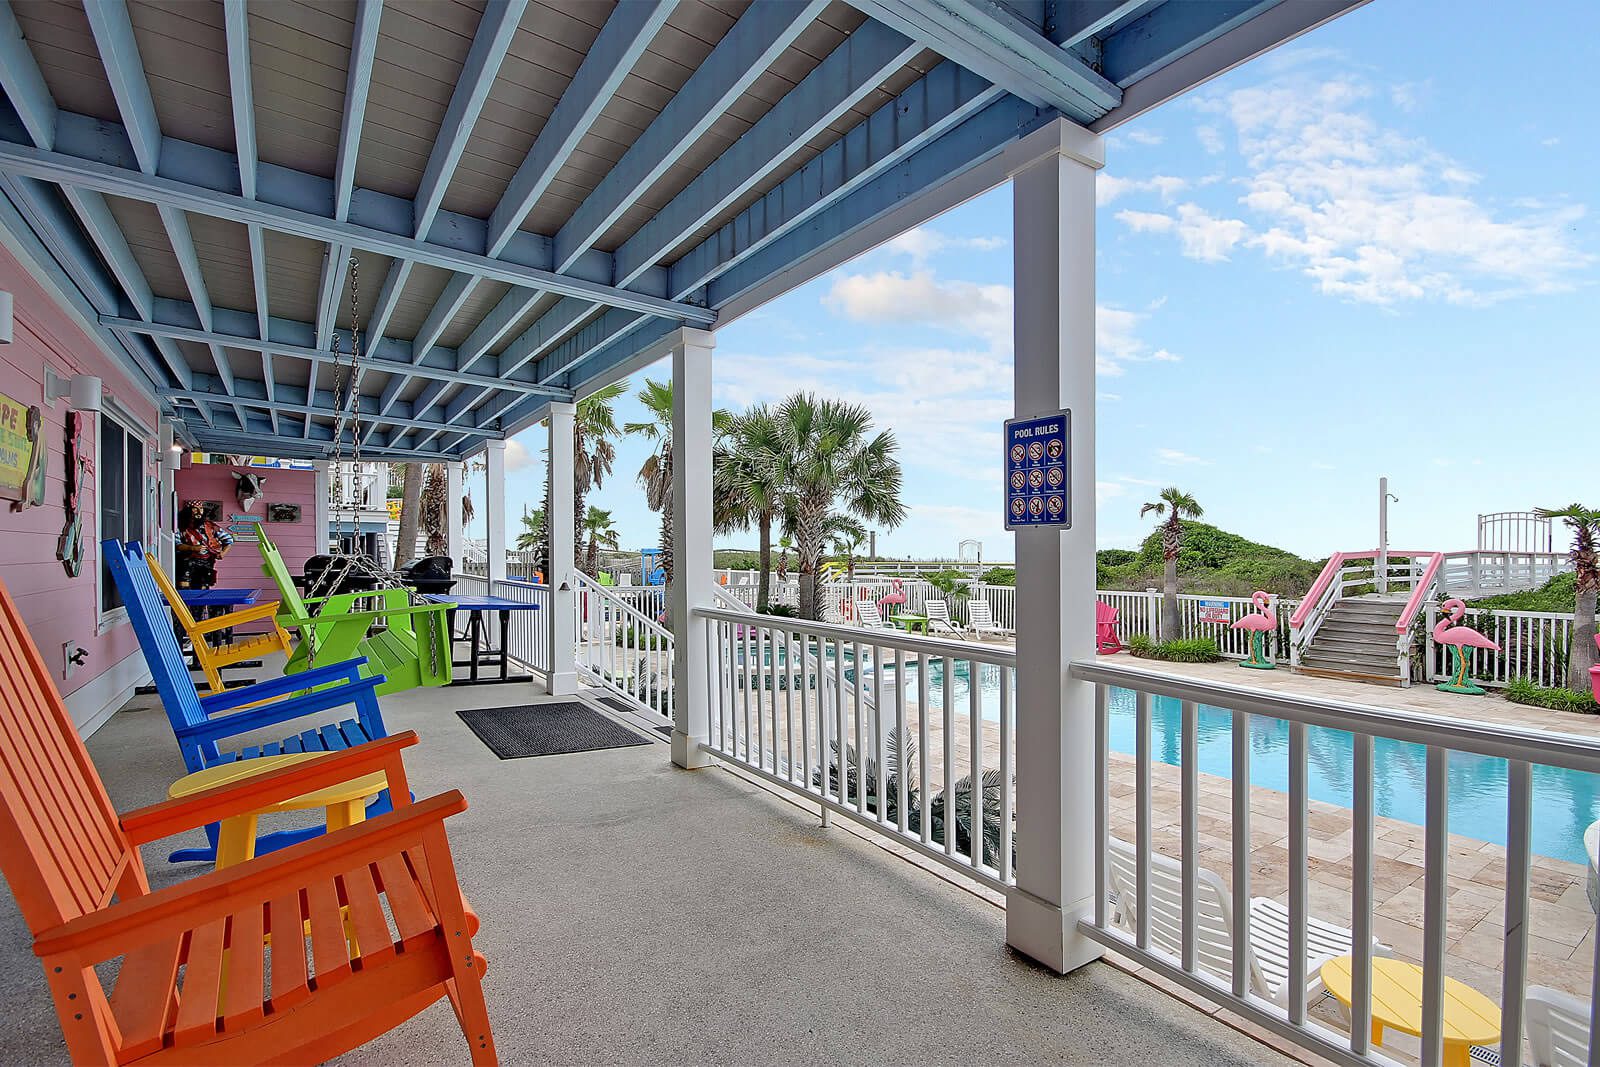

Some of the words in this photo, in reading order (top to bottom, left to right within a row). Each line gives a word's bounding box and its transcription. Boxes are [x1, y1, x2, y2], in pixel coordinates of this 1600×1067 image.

[0, 402, 19, 430] PE
[1014, 428, 1033, 438] POOL
[1035, 424, 1059, 436] RULES
[1206, 607, 1228, 615] LIFEGUARD
